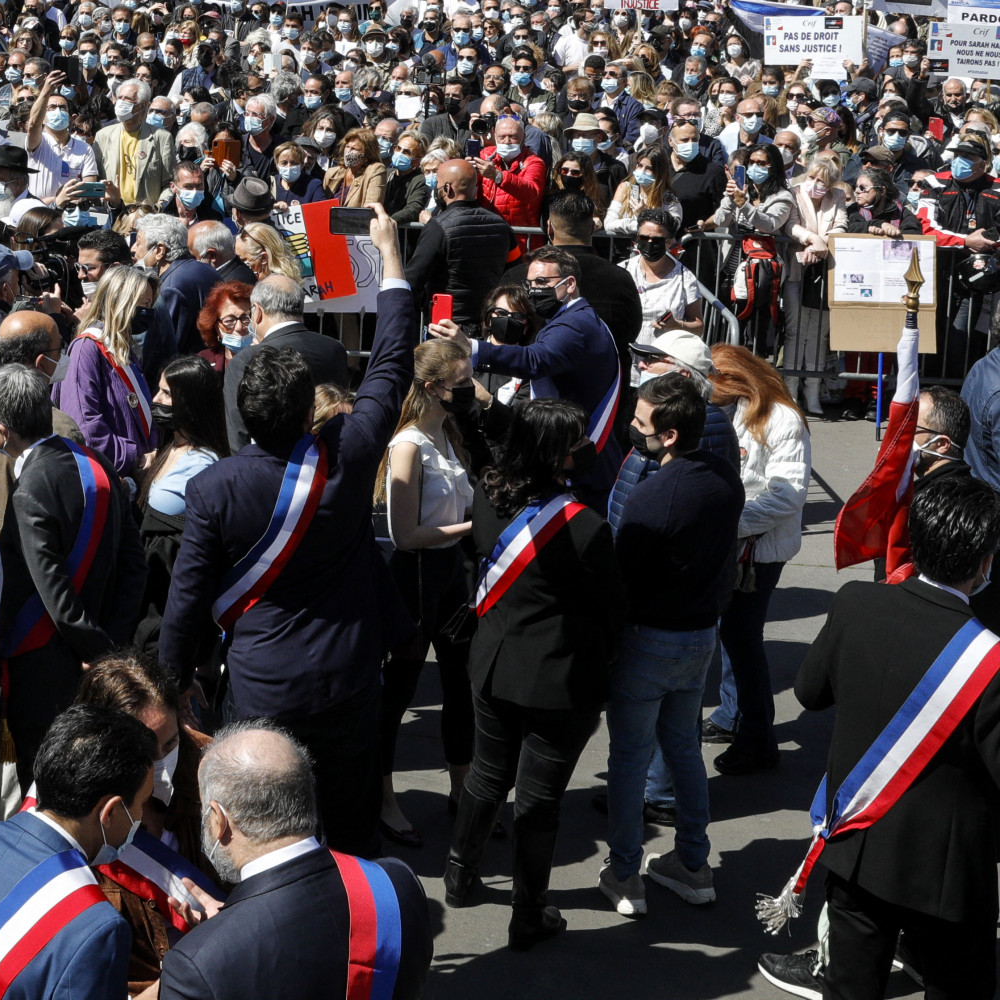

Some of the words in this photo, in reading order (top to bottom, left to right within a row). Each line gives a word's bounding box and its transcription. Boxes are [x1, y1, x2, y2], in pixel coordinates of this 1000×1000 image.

[621, 0, 660, 10] INJUSTICE
[961, 12, 1000, 24] PARD
[802, 19, 818, 28] Crif
[783, 32, 799, 40] PAS
[801, 32, 812, 40] DE
[813, 32, 839, 41] DROIT
[973, 27, 991, 37] Crif
[779, 44, 801, 53] SANS
[802, 44, 837, 53] JUSTICE
[957, 58, 983, 66] TAIRONS
[273, 211, 302, 226] TICE
[302, 280, 334, 298] ARAH
